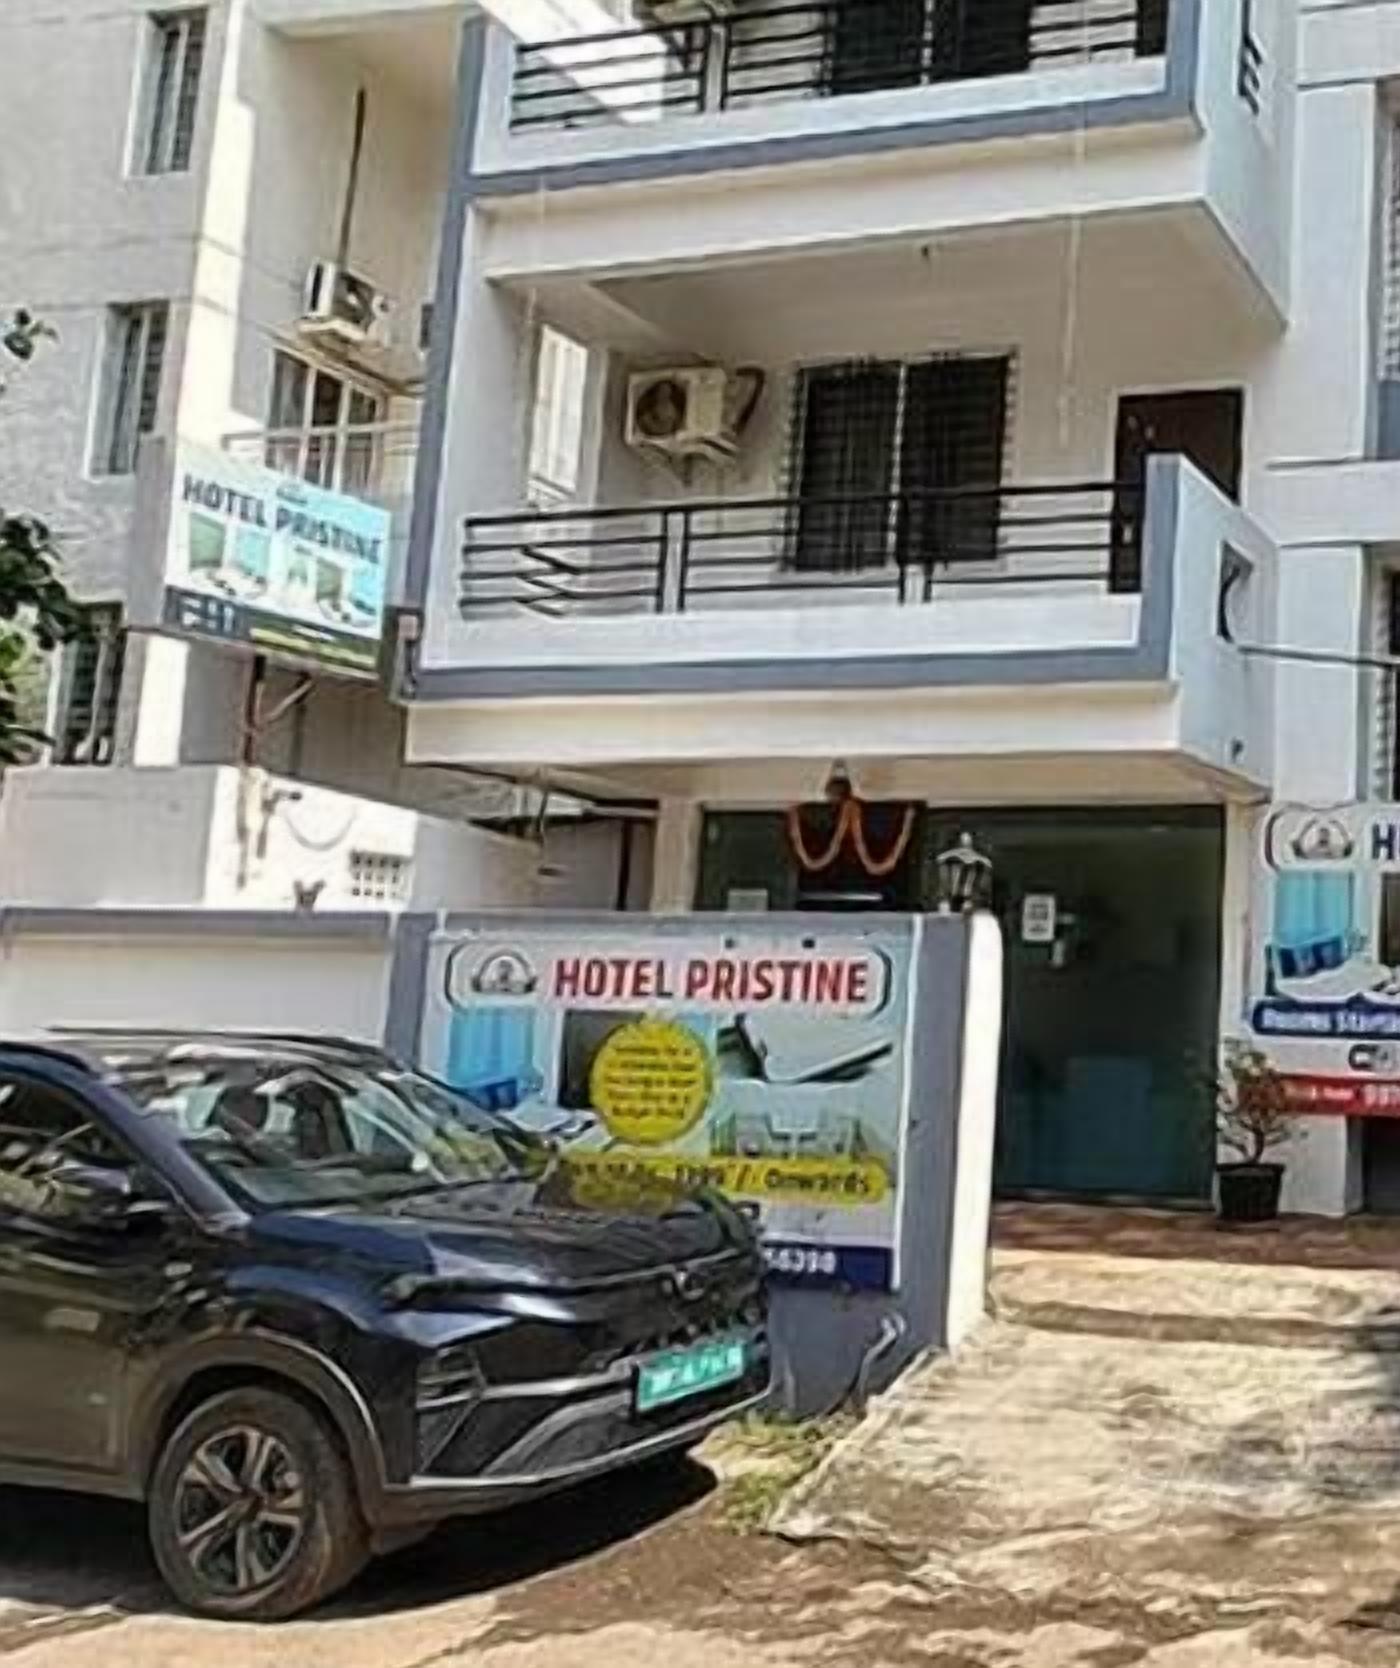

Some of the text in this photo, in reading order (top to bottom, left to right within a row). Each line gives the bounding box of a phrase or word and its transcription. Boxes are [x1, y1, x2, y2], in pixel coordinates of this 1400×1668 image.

[183, 472, 381, 564] HOTEL PRISTINE
[555, 957, 869, 1003] HOTEL PRISTINE
